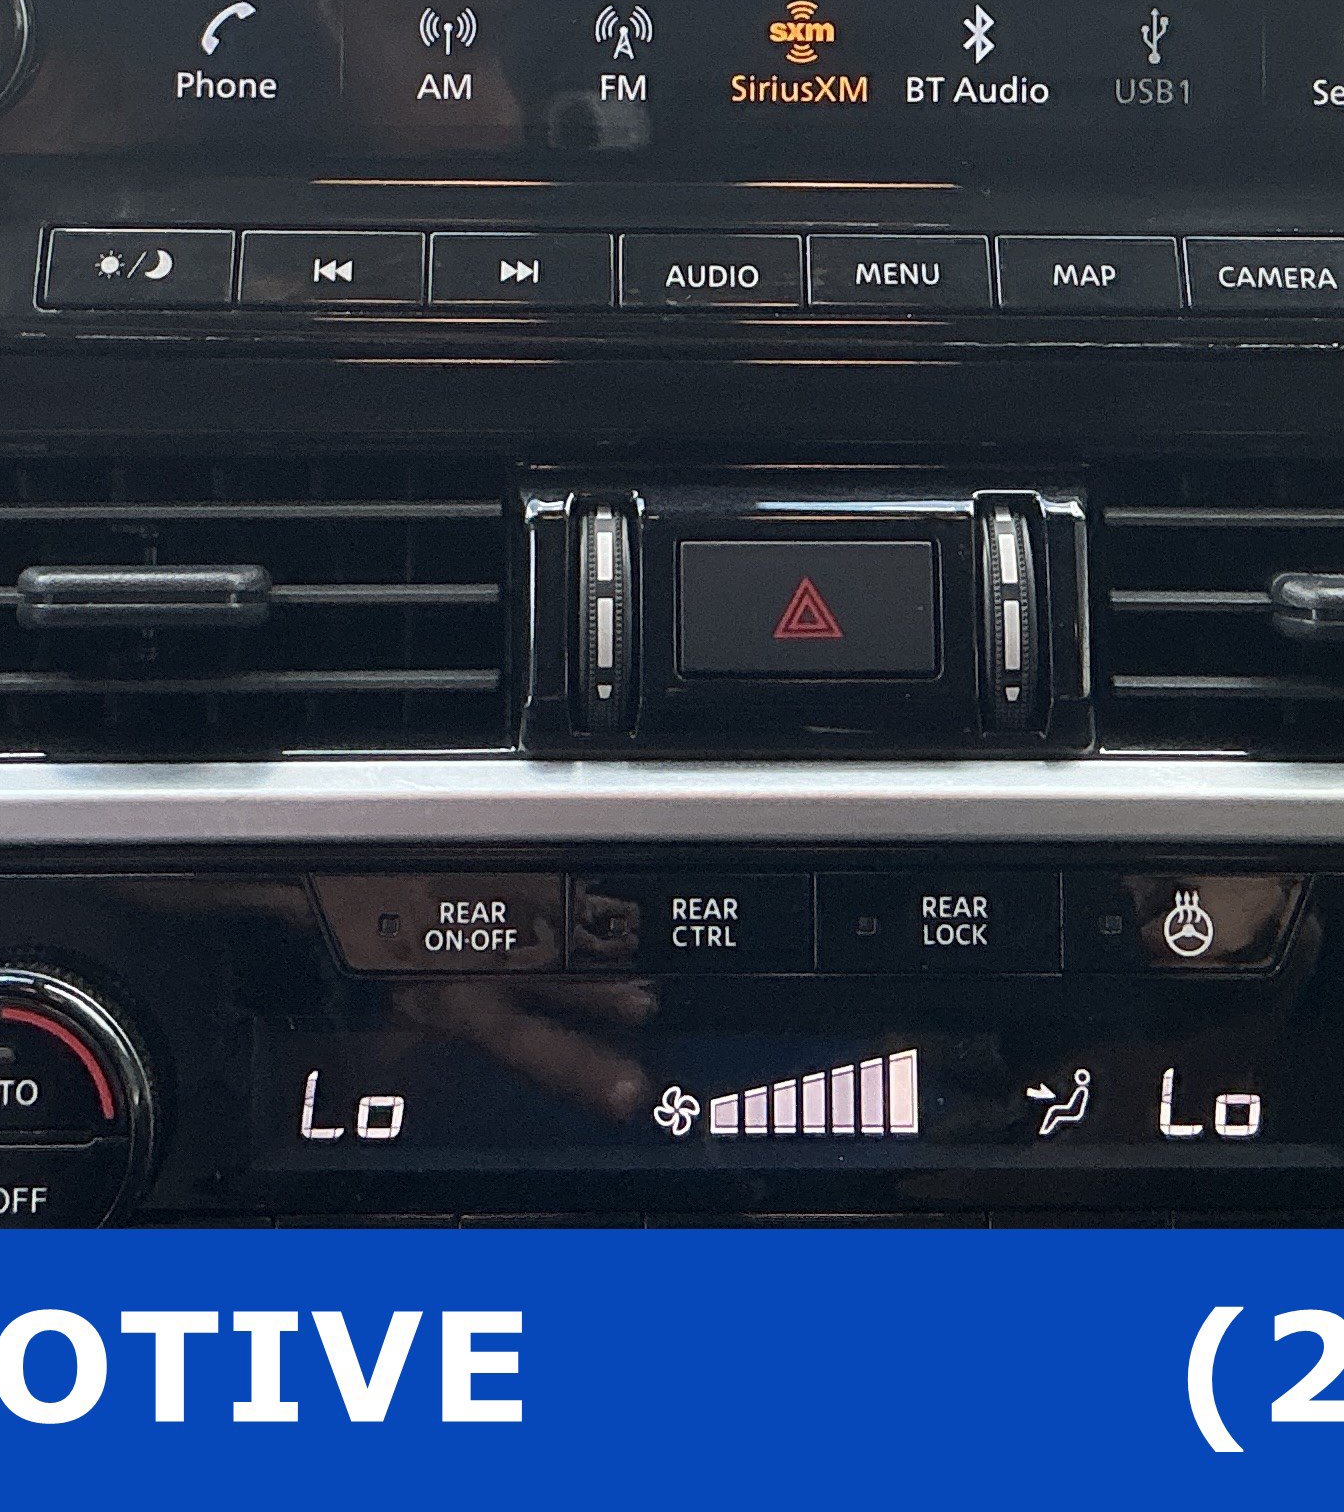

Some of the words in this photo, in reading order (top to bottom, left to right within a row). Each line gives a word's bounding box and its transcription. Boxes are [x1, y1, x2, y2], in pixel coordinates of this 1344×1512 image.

[769, 21, 836, 43] sxm
[175, 71, 279, 101] Phone
[416, 73, 474, 101] AM
[599, 75, 649, 102] FM
[731, 74, 870, 103] SiriusXM
[905, 76, 945, 104] BT
[952, 74, 1051, 105] Audio
[1115, 78, 1193, 106] USB1
[665, 263, 760, 289] AUDIO
[855, 261, 942, 286] MENU
[1052, 262, 1117, 287] MAP
[1217, 264, 1339, 290] CAMERA
[438, 900, 508, 925] REAR
[671, 897, 740, 921] REAR
[921, 895, 989, 919] REAR
[671, 924, 738, 948] CTRL
[921, 923, 989, 947] LOCK
[299, 1069, 407, 1140] Lo
[1158, 1066, 1263, 1139] Lo
